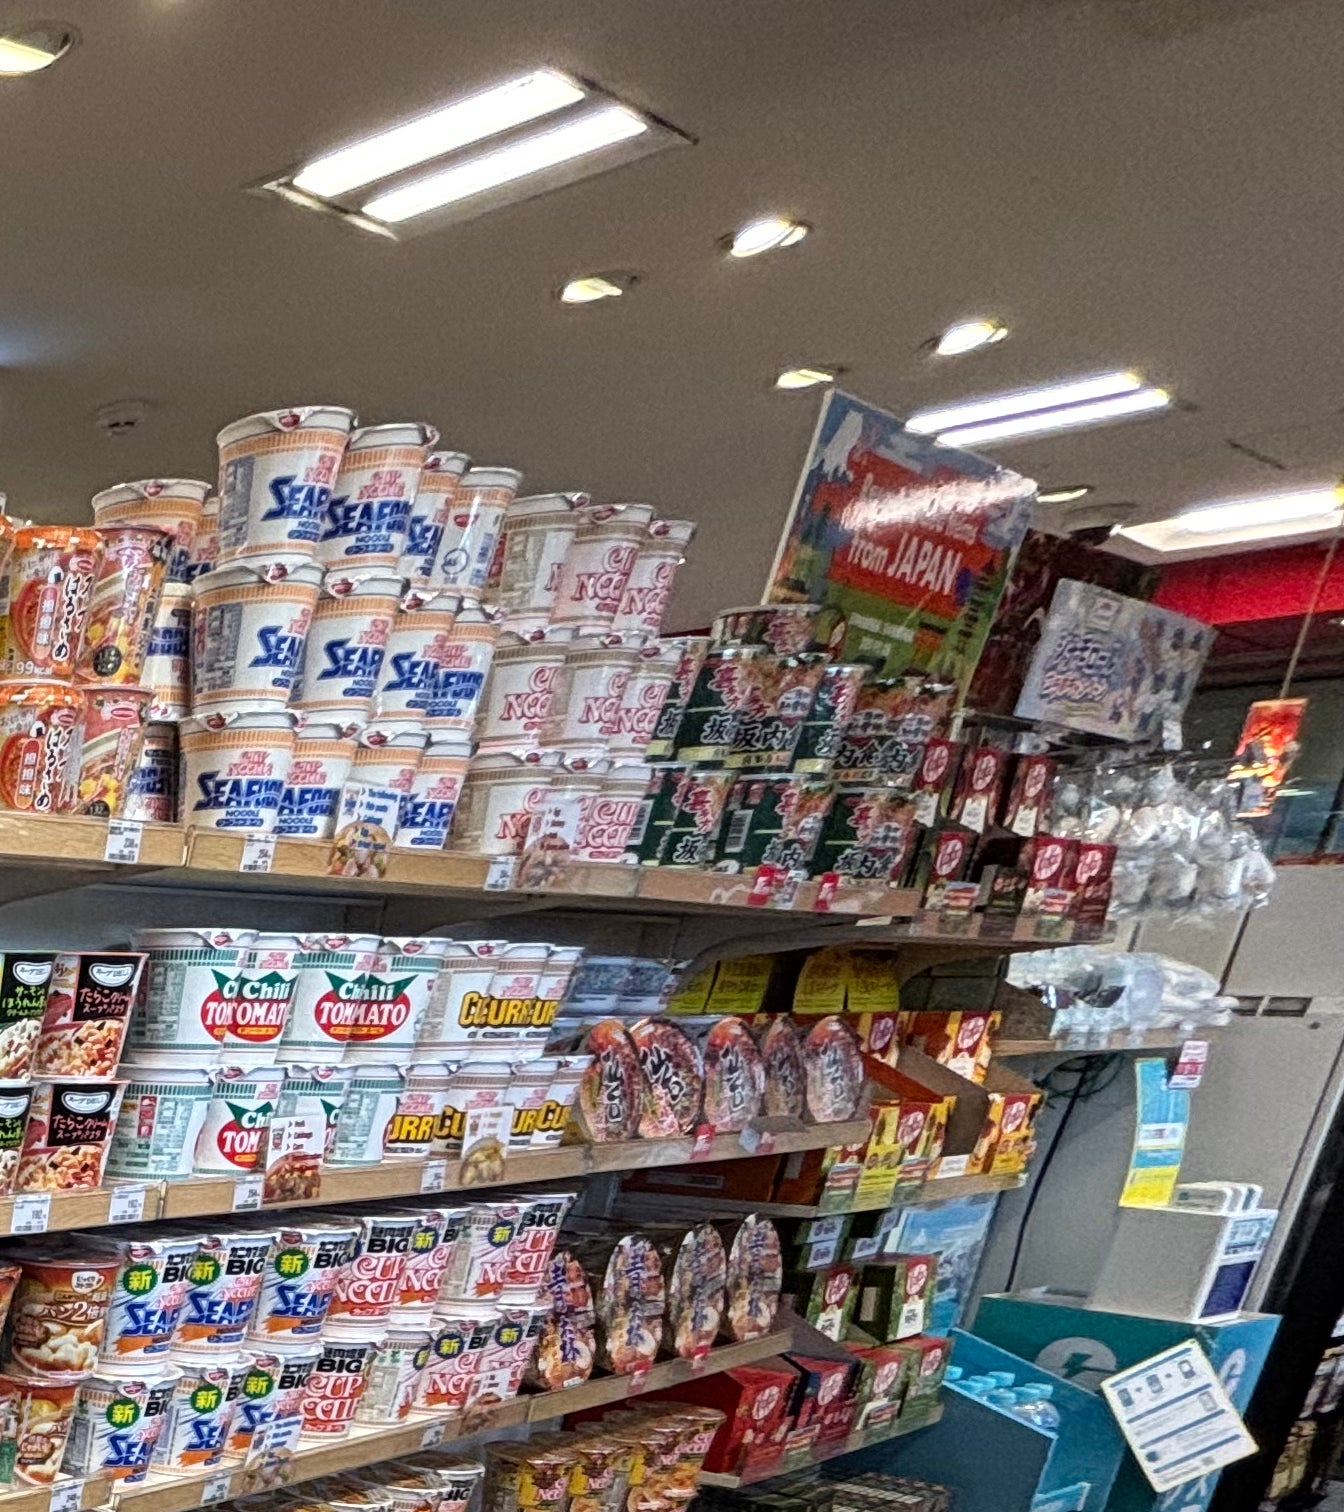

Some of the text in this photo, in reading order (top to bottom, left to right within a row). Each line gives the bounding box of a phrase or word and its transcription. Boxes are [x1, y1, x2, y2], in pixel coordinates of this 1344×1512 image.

[318, 495, 412, 541] SEAFOO
[848, 534, 966, 596] from JAPAN
[40, 594, 54, 651] 担担味
[22, 746, 36, 795] 担担味
[225, 808, 260, 817] NOODLE
[227, 1003, 288, 1024] TOMAT
[226, 1259, 264, 1274] BIG
[280, 1253, 302, 1273] 新
[128, 1270, 151, 1290] 新
[317, 1358, 363, 1372] BIG
